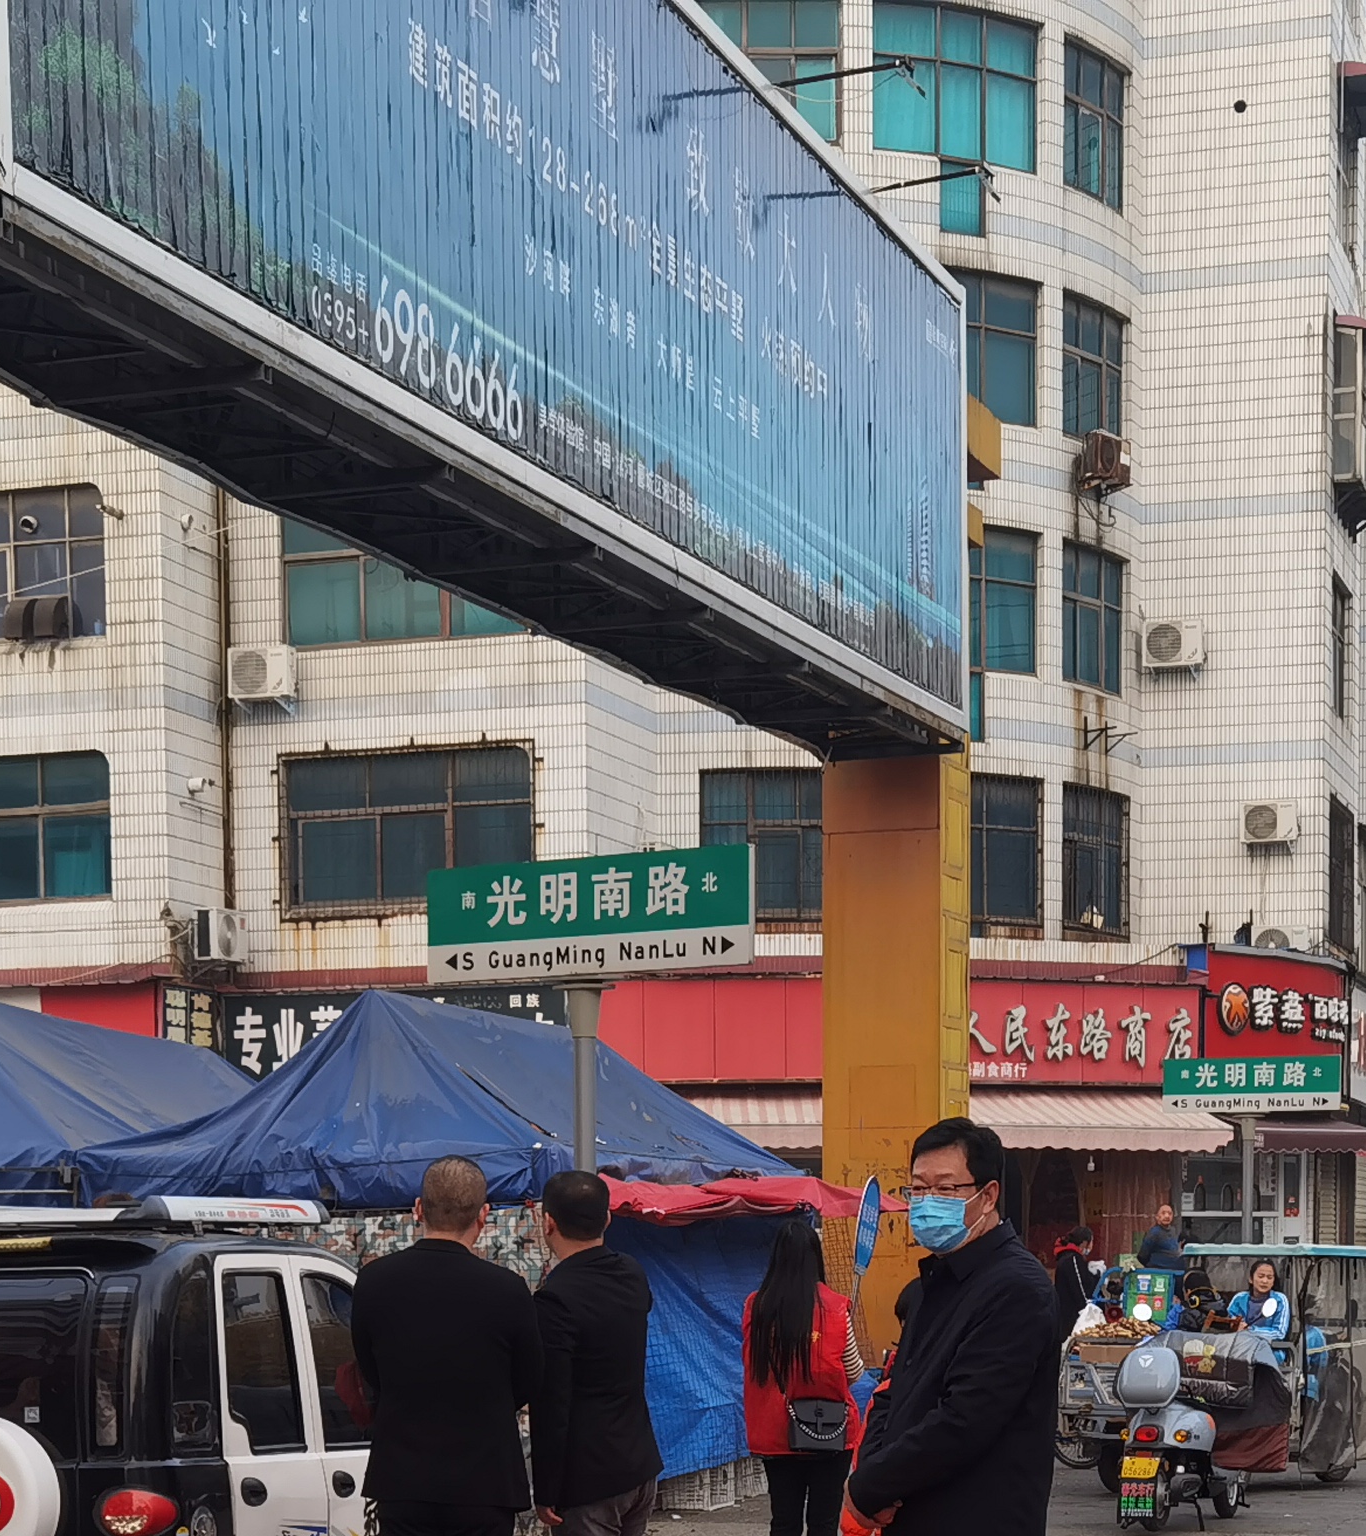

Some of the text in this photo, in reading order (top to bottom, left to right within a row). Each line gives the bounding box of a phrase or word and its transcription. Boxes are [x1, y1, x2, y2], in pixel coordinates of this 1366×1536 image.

[461, 862, 718, 928] 南 光明南路 北
[462, 936, 716, 972] S GuangMing NanLu N
[509, 993, 540, 1009] 回族
[969, 1003, 1192, 1068] 人民东路商店
[969, 1061, 1027, 1078] 副食商行
[1195, 1062, 1307, 1088] 光明南路
[1312, 1066, 1322, 1078] 北
[1195, 1098, 1260, 1110] GuangMing
[1268, 1097, 1305, 1108] NanLu
